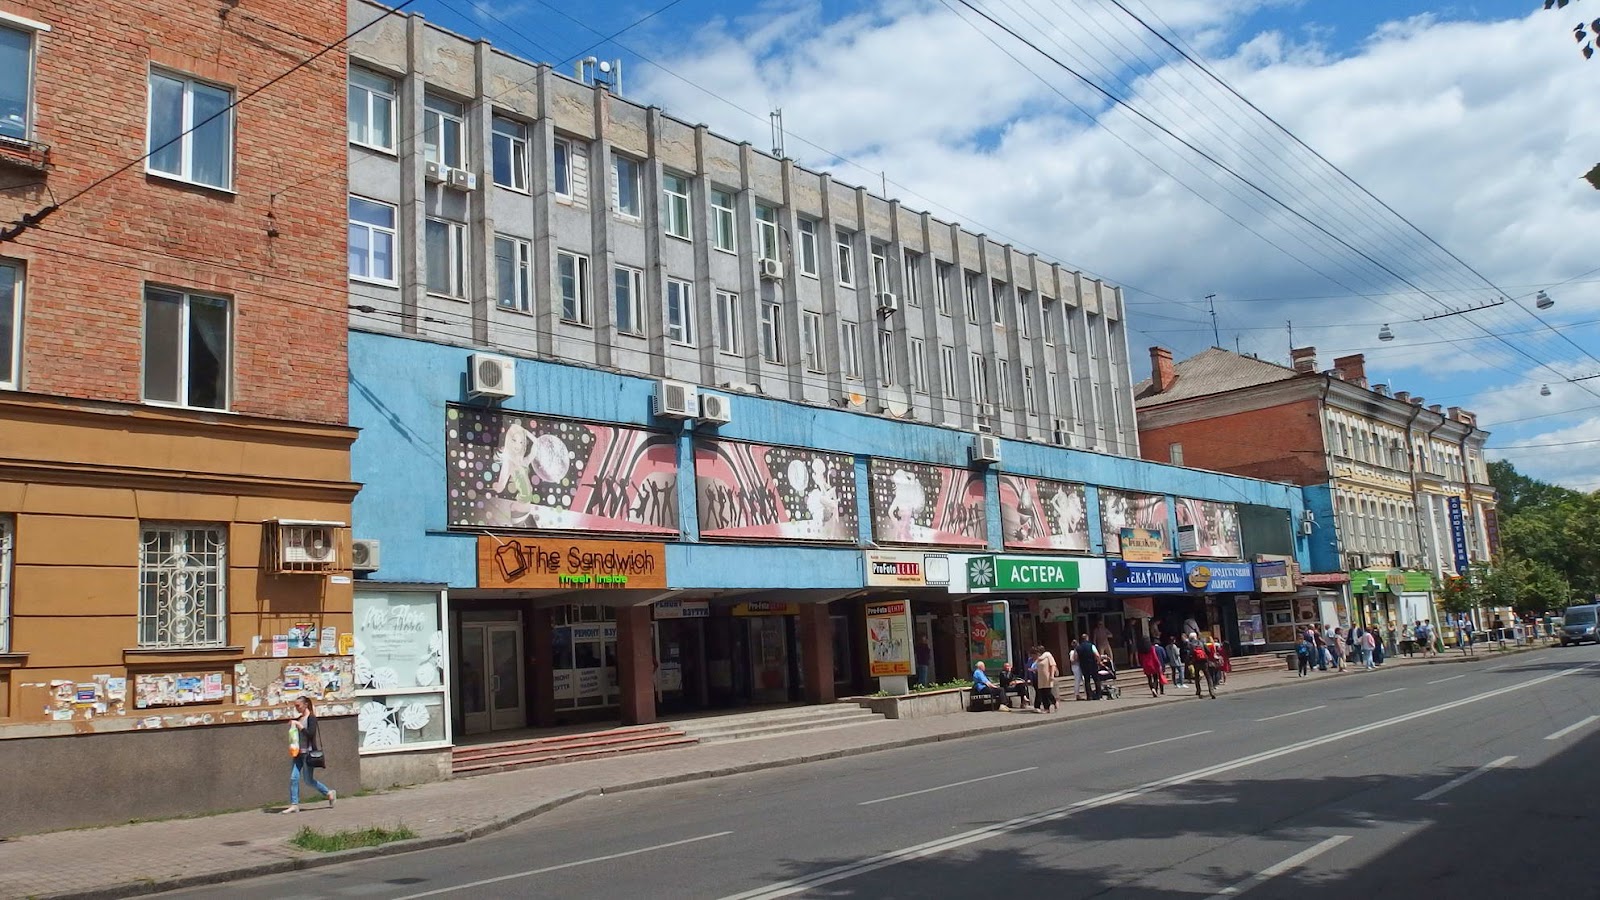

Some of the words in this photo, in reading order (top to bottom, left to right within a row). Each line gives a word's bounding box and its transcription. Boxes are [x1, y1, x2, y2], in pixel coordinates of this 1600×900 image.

[524, 545, 561, 568] The
[569, 547, 655, 570] Sandwich
[1010, 565, 1065, 583] АСТЕРА
[574, 628, 600, 638] РЕМОНТ
[603, 628, 617, 637] ВЗУ
